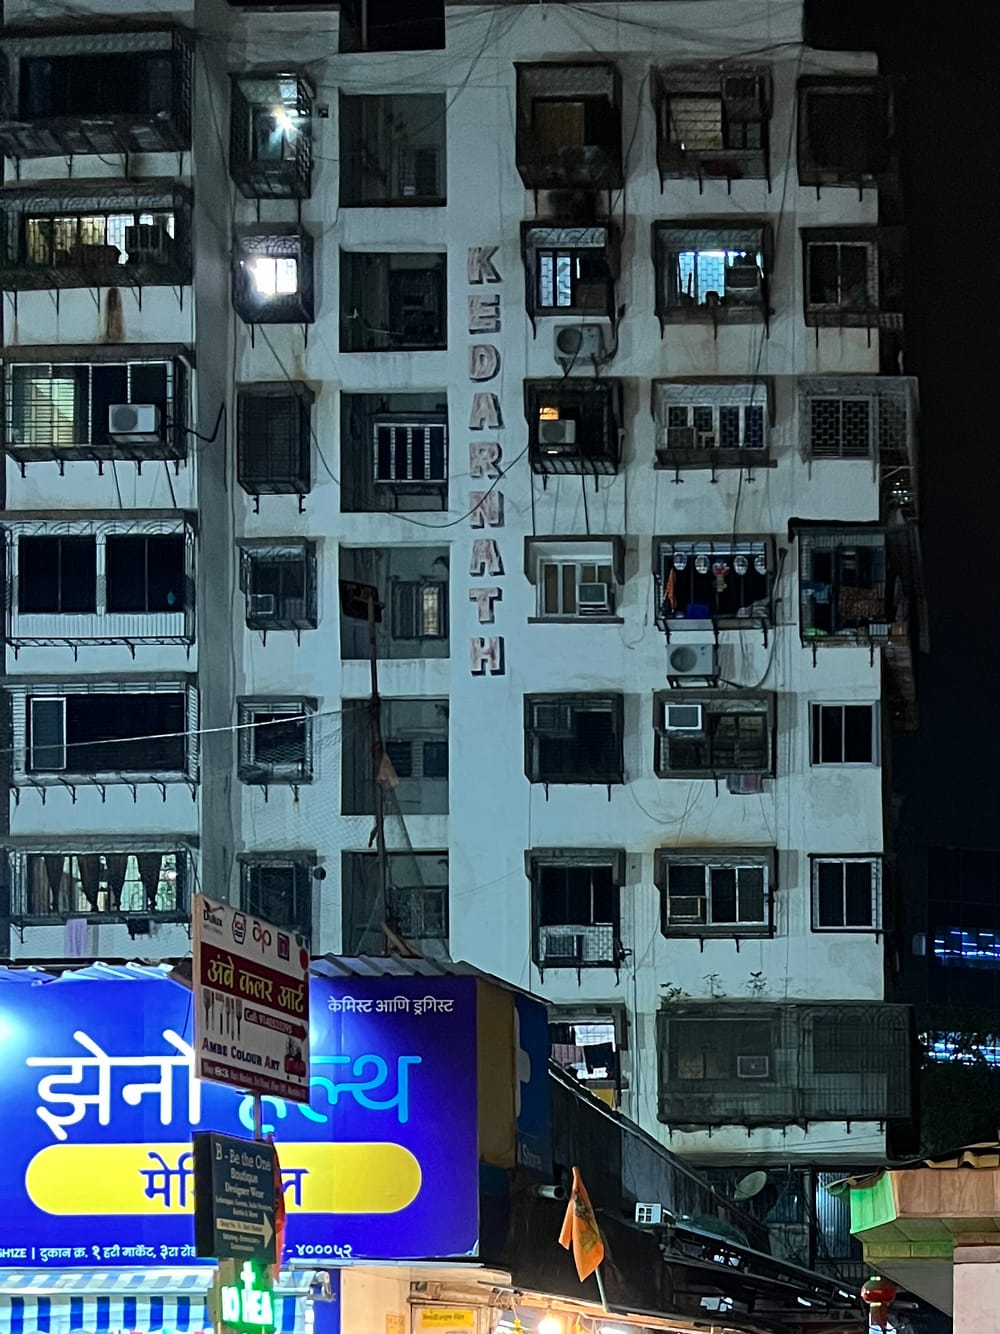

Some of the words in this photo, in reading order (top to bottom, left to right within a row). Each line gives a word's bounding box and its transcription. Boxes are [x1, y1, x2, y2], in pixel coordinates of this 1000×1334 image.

[468, 245, 505, 677] KEDARNATH
[207, 954, 236, 990] अंबे
[239, 969, 274, 1003] कलर
[277, 983, 305, 1014] आर्ट
[328, 996, 373, 1013] केमिस्ट
[375, 996, 410, 1013] आणि
[414, 996, 455, 1016] ड्रगिस्ट
[202, 1037, 228, 1058] AMBE
[264, 1055, 281, 1072] ART
[26, 1030, 200, 1140] झेनो
[214, 1065, 230, 1079] 83
[216, 1143, 223, 1161] B
[229, 1149, 240, 1165] Be
[241, 1152, 255, 1169] the
[39, 1247, 72, 1262] दुकान
[296, 1244, 353, 1259] ४०००५२
